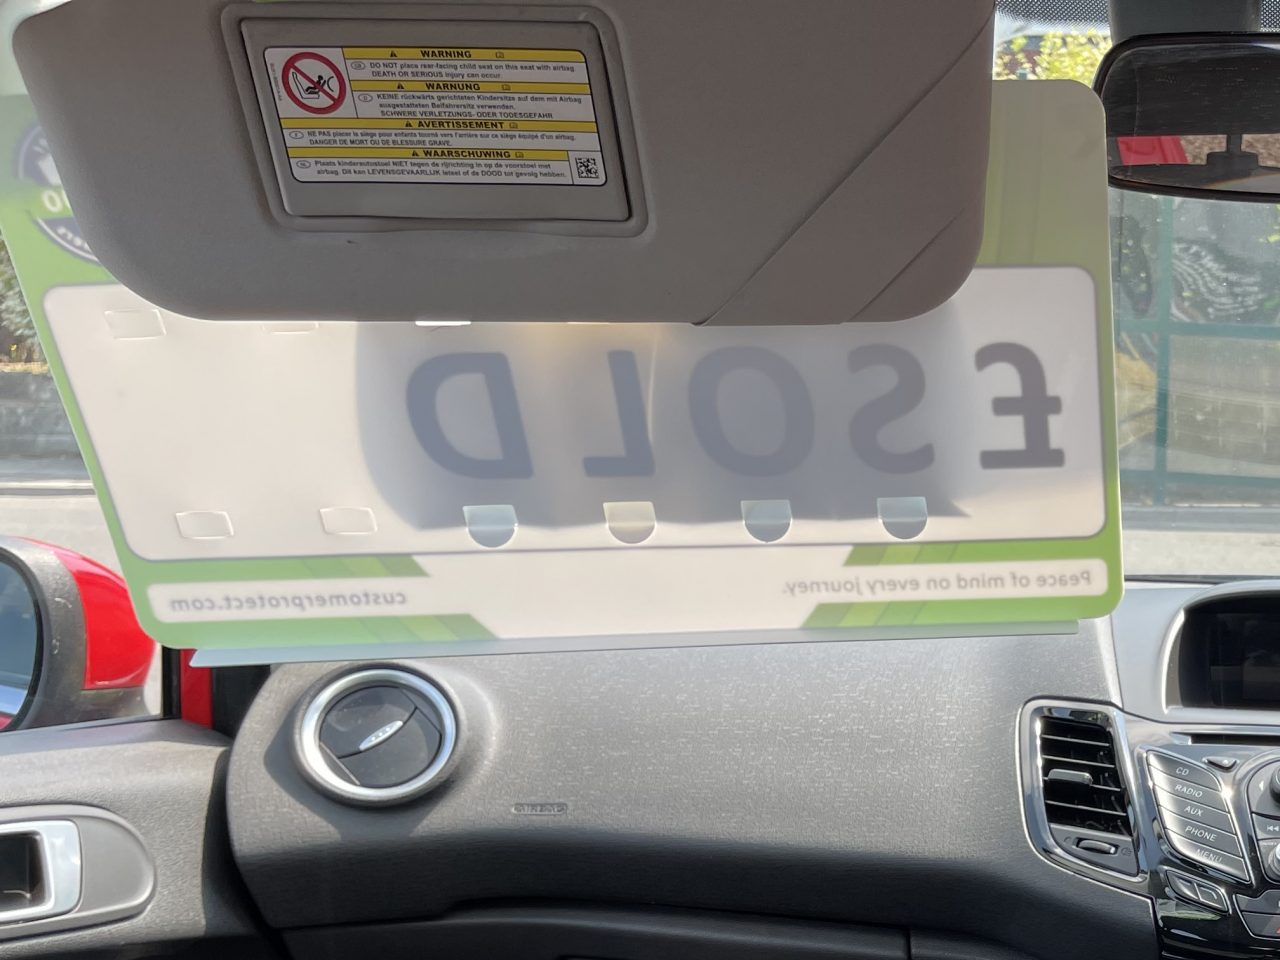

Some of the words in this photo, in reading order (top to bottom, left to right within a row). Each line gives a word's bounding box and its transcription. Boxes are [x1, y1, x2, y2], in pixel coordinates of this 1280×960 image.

[420, 50, 472, 58] WARNING
[425, 82, 480, 91] WARNUNG
[559, 96, 582, 104] Airbag
[417, 121, 504, 129] AVERTISSEMENT
[423, 149, 511, 158] WAARSCHUWING
[1175, 766, 1190, 776] CD
[1174, 784, 1203, 798] RADIO
[1184, 805, 1204, 817] AUX
[1185, 825, 1218, 842] PHONE
[1197, 849, 1222, 863] MENU
